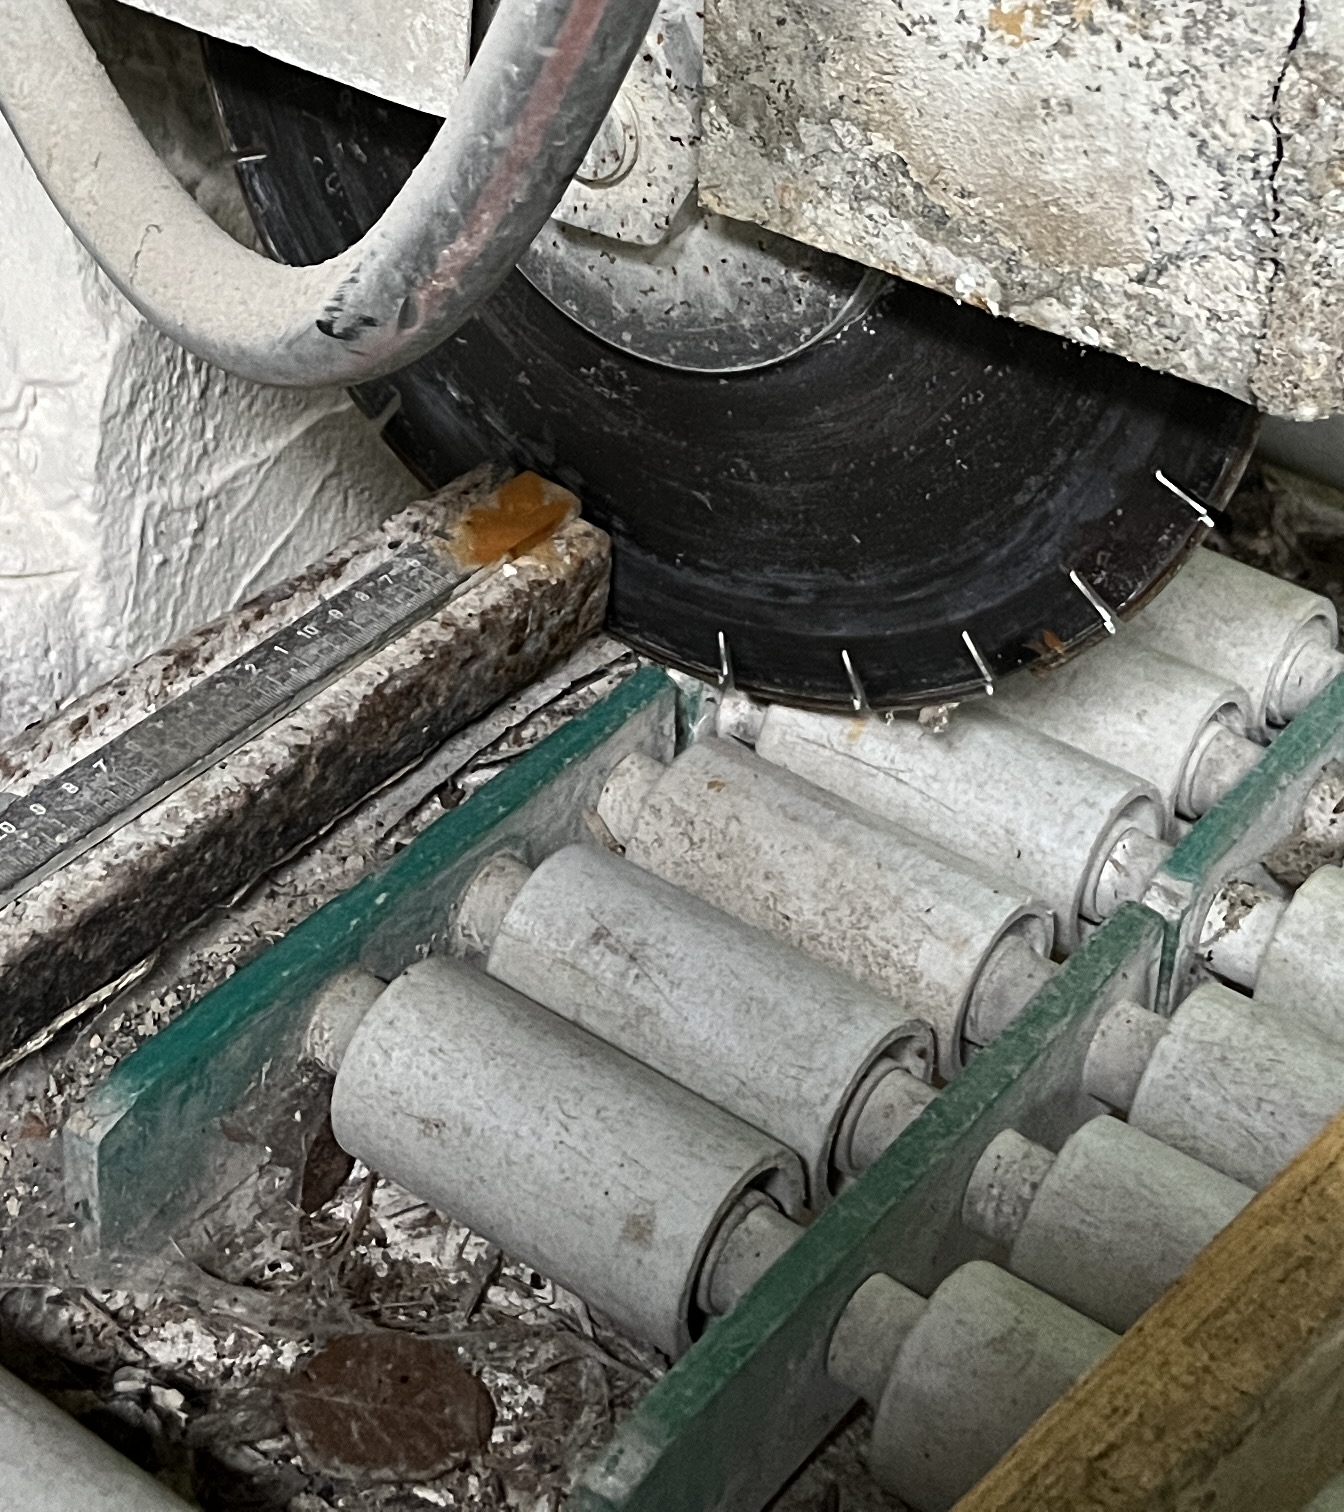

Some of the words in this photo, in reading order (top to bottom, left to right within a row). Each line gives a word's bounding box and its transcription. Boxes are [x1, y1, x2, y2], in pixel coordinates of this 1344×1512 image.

[61, 782, 79, 794] 8
[92, 758, 107, 773] 7
[273, 645, 289, 655] 1
[296, 625, 320, 639] 10
[354, 591, 370, 602] 8
[378, 574, 394, 585] 7
